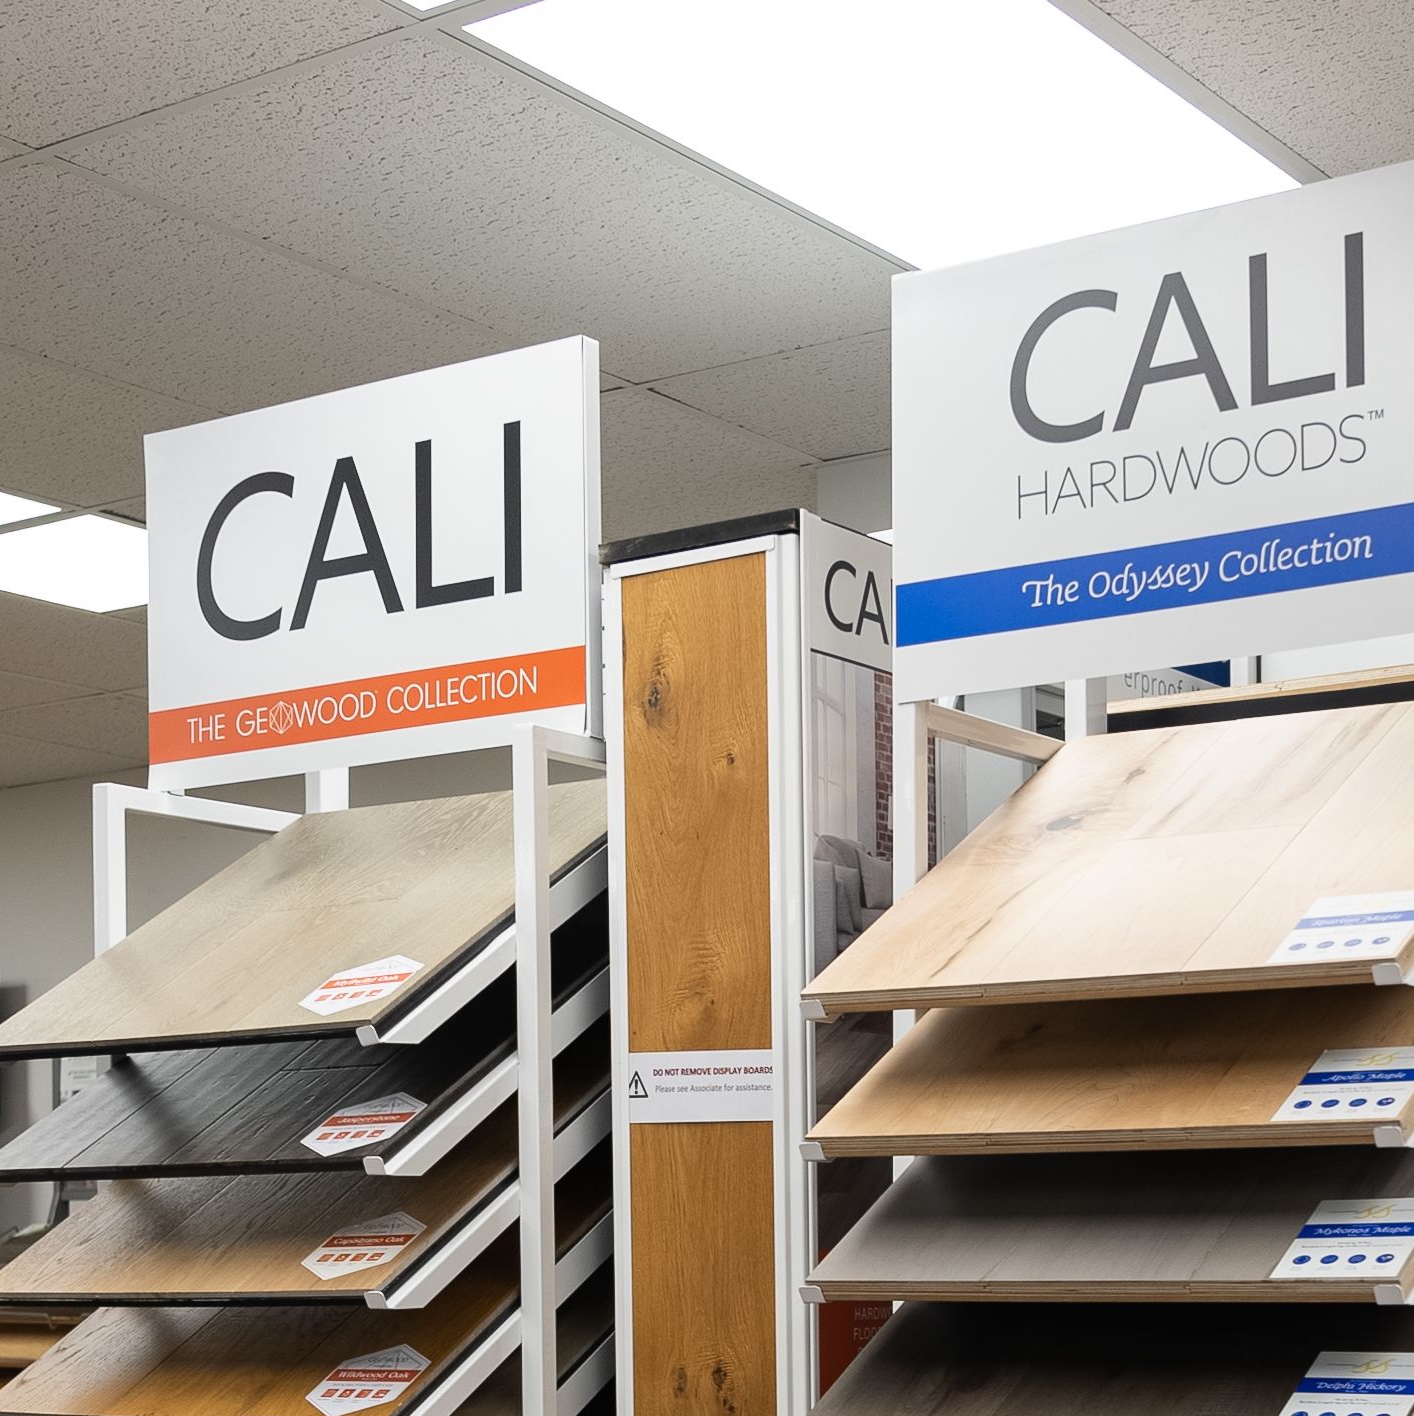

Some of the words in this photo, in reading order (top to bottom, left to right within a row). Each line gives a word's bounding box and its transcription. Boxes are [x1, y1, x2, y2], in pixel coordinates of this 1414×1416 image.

[1009, 231, 1366, 444] CALI
[197, 421, 522, 640] CALI
[1023, 574, 1079, 608] The
[1088, 561, 1209, 602] Odyssey
[1219, 534, 1372, 582] Collection
[824, 560, 893, 645] CA
[1124, 671, 1184, 698] erproof
[187, 713, 226, 745] THE
[388, 666, 538, 714] COLLECTION
[653, 1068, 663, 1077] DO
[665, 1068, 679, 1077] NOT
[681, 1067, 711, 1076] REMOVE
[713, 1066, 742, 1075] DISPLAY
[1368, 1070, 1406, 1081] Maple
[655, 1085, 675, 1093] Please
[690, 1084, 722, 1093] Associate
[724, 1083, 734, 1092] for
[735, 1084, 773, 1092] assistance.
[1314, 1226, 1370, 1236] Mykonos
[1372, 1225, 1411, 1235] Maple
[854, 1307, 891, 1320] HARDW
[338, 1370, 386, 1379] Wildwood
[388, 1371, 410, 1379] Oak
[1358, 1381, 1406, 1392] Hickory
